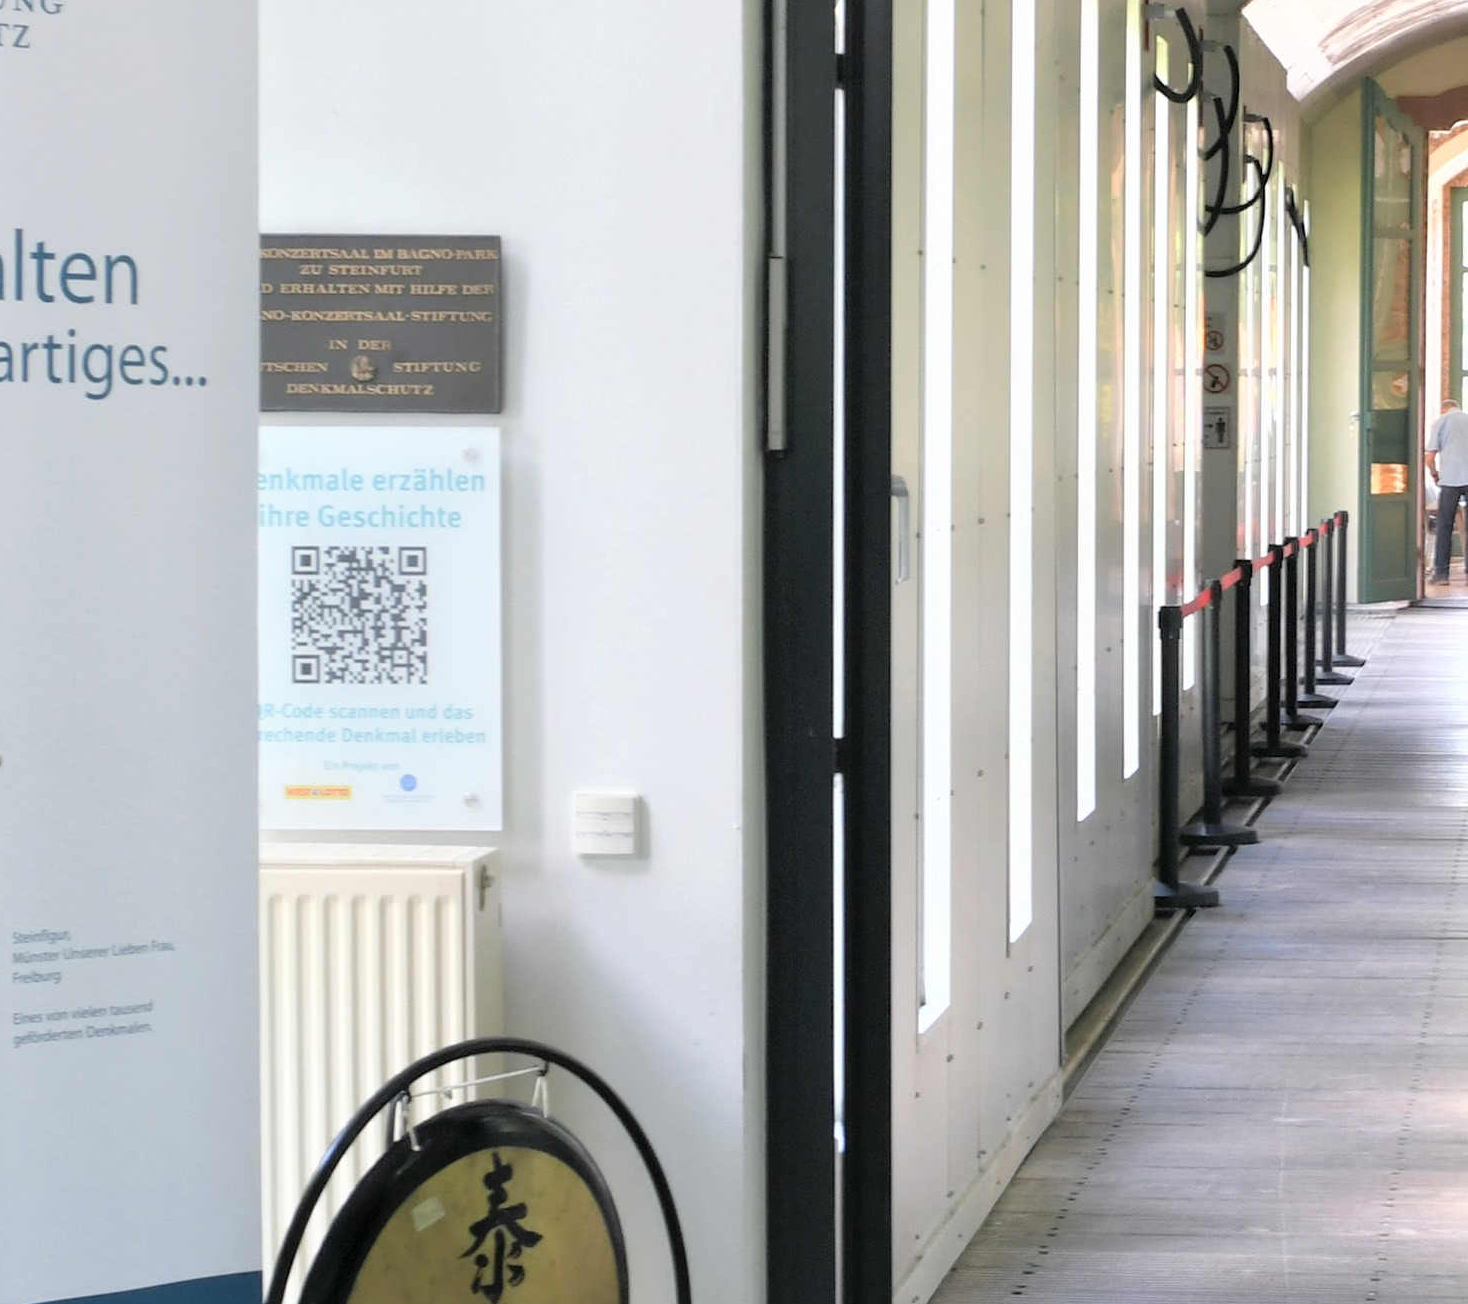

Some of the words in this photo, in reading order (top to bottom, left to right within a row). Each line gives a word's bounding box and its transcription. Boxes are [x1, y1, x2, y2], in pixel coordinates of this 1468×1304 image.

[374, 248, 394, 260] IM
[299, 264, 323, 276] ZU
[328, 264, 424, 276] STEINFURT
[280, 283, 371, 295] ERHALTEN
[374, 283, 406, 295] MIT
[410, 284, 458, 296] HILFE
[462, 284, 495, 296] DER
[261, 310, 494, 323] NO-KONZERTSAAL-STIFTUNG
[328, 339, 349, 351] IN
[358, 339, 393, 351] DER
[260, 361, 330, 373] TSCHEN
[393, 361, 482, 373] STIFTUNG
[286, 383, 435, 396] DENKMALSCHUTZ
[257, 467, 365, 492] enkmale
[372, 468, 486, 492] erzählen
[259, 504, 310, 528] ihre
[317, 504, 462, 529] Geschichte
[329, 706, 400, 720] scannen
[405, 703, 437, 720] und
[442, 703, 474, 720] das
[341, 727, 417, 744] Denkmal
[421, 727, 487, 744] erleben
